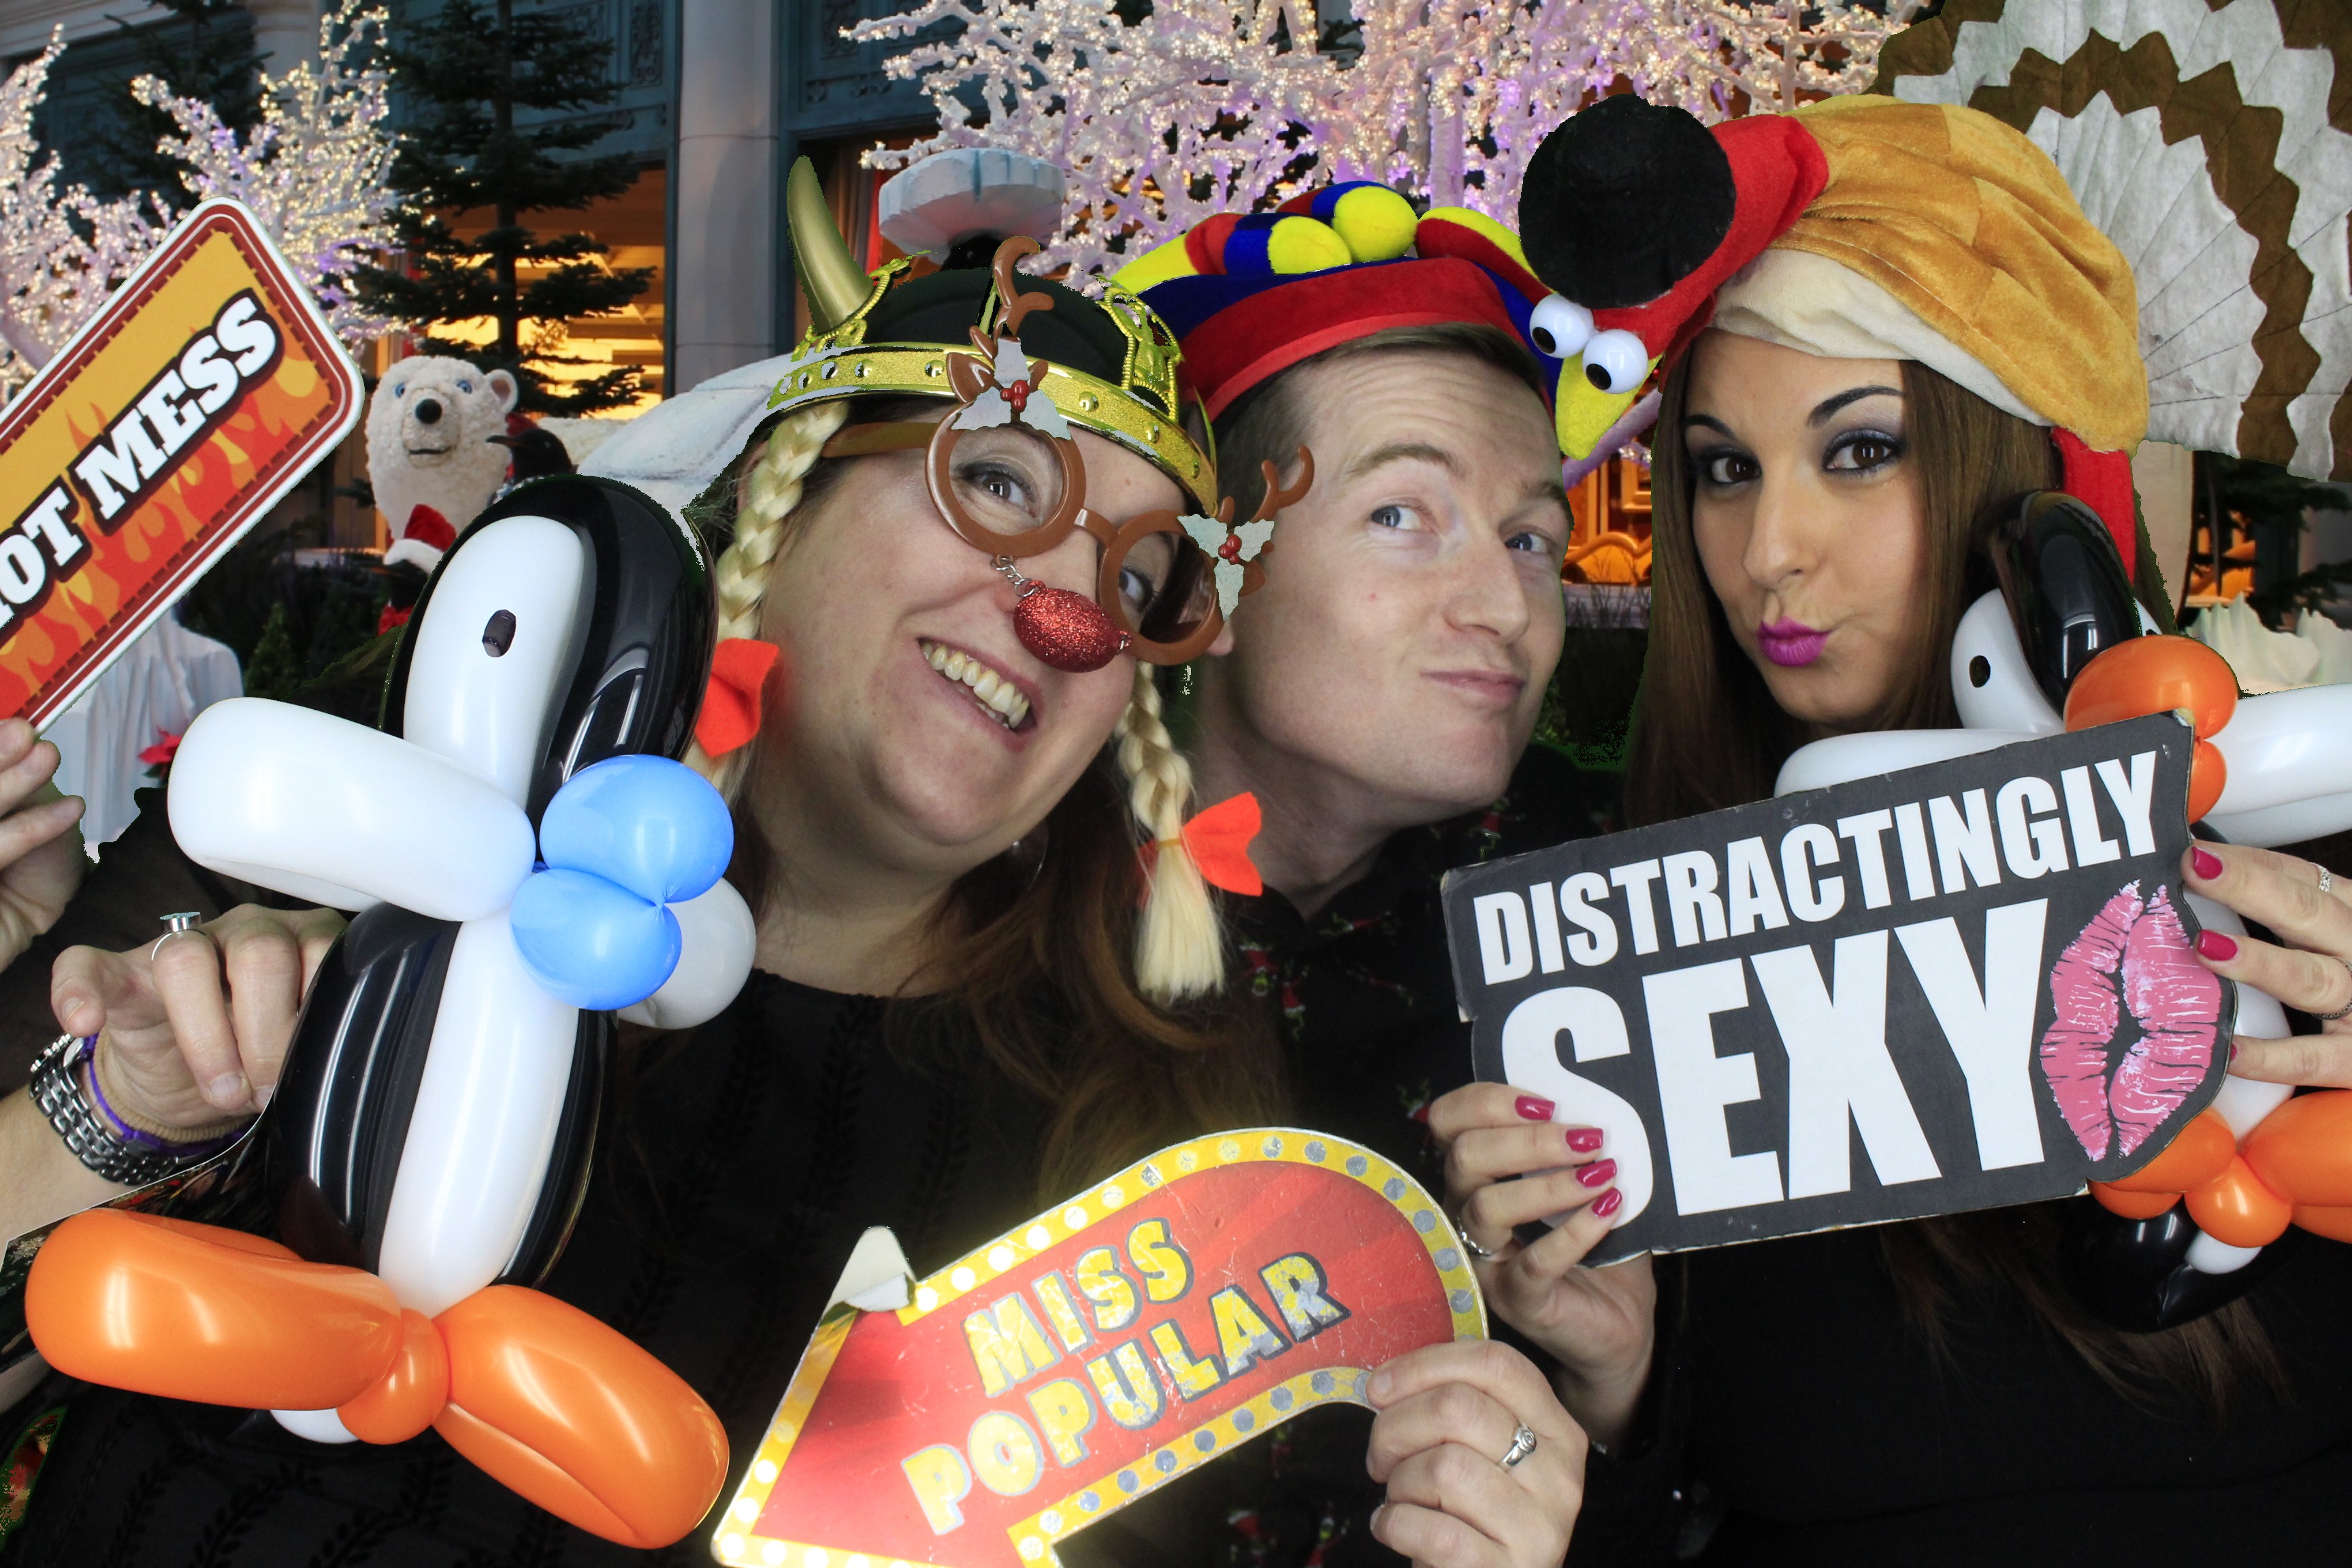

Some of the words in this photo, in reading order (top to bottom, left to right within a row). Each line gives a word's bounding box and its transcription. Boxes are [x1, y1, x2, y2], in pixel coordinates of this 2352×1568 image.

[0, 485, 83, 629] OT
[75, 295, 278, 519] MESS
[1473, 750, 2159, 985] DISTRACTINGLY
[1501, 898, 2049, 1230] SEXY
[902, 1252, 1350, 1535] POPULAR
[964, 1218, 1195, 1397] MISS
